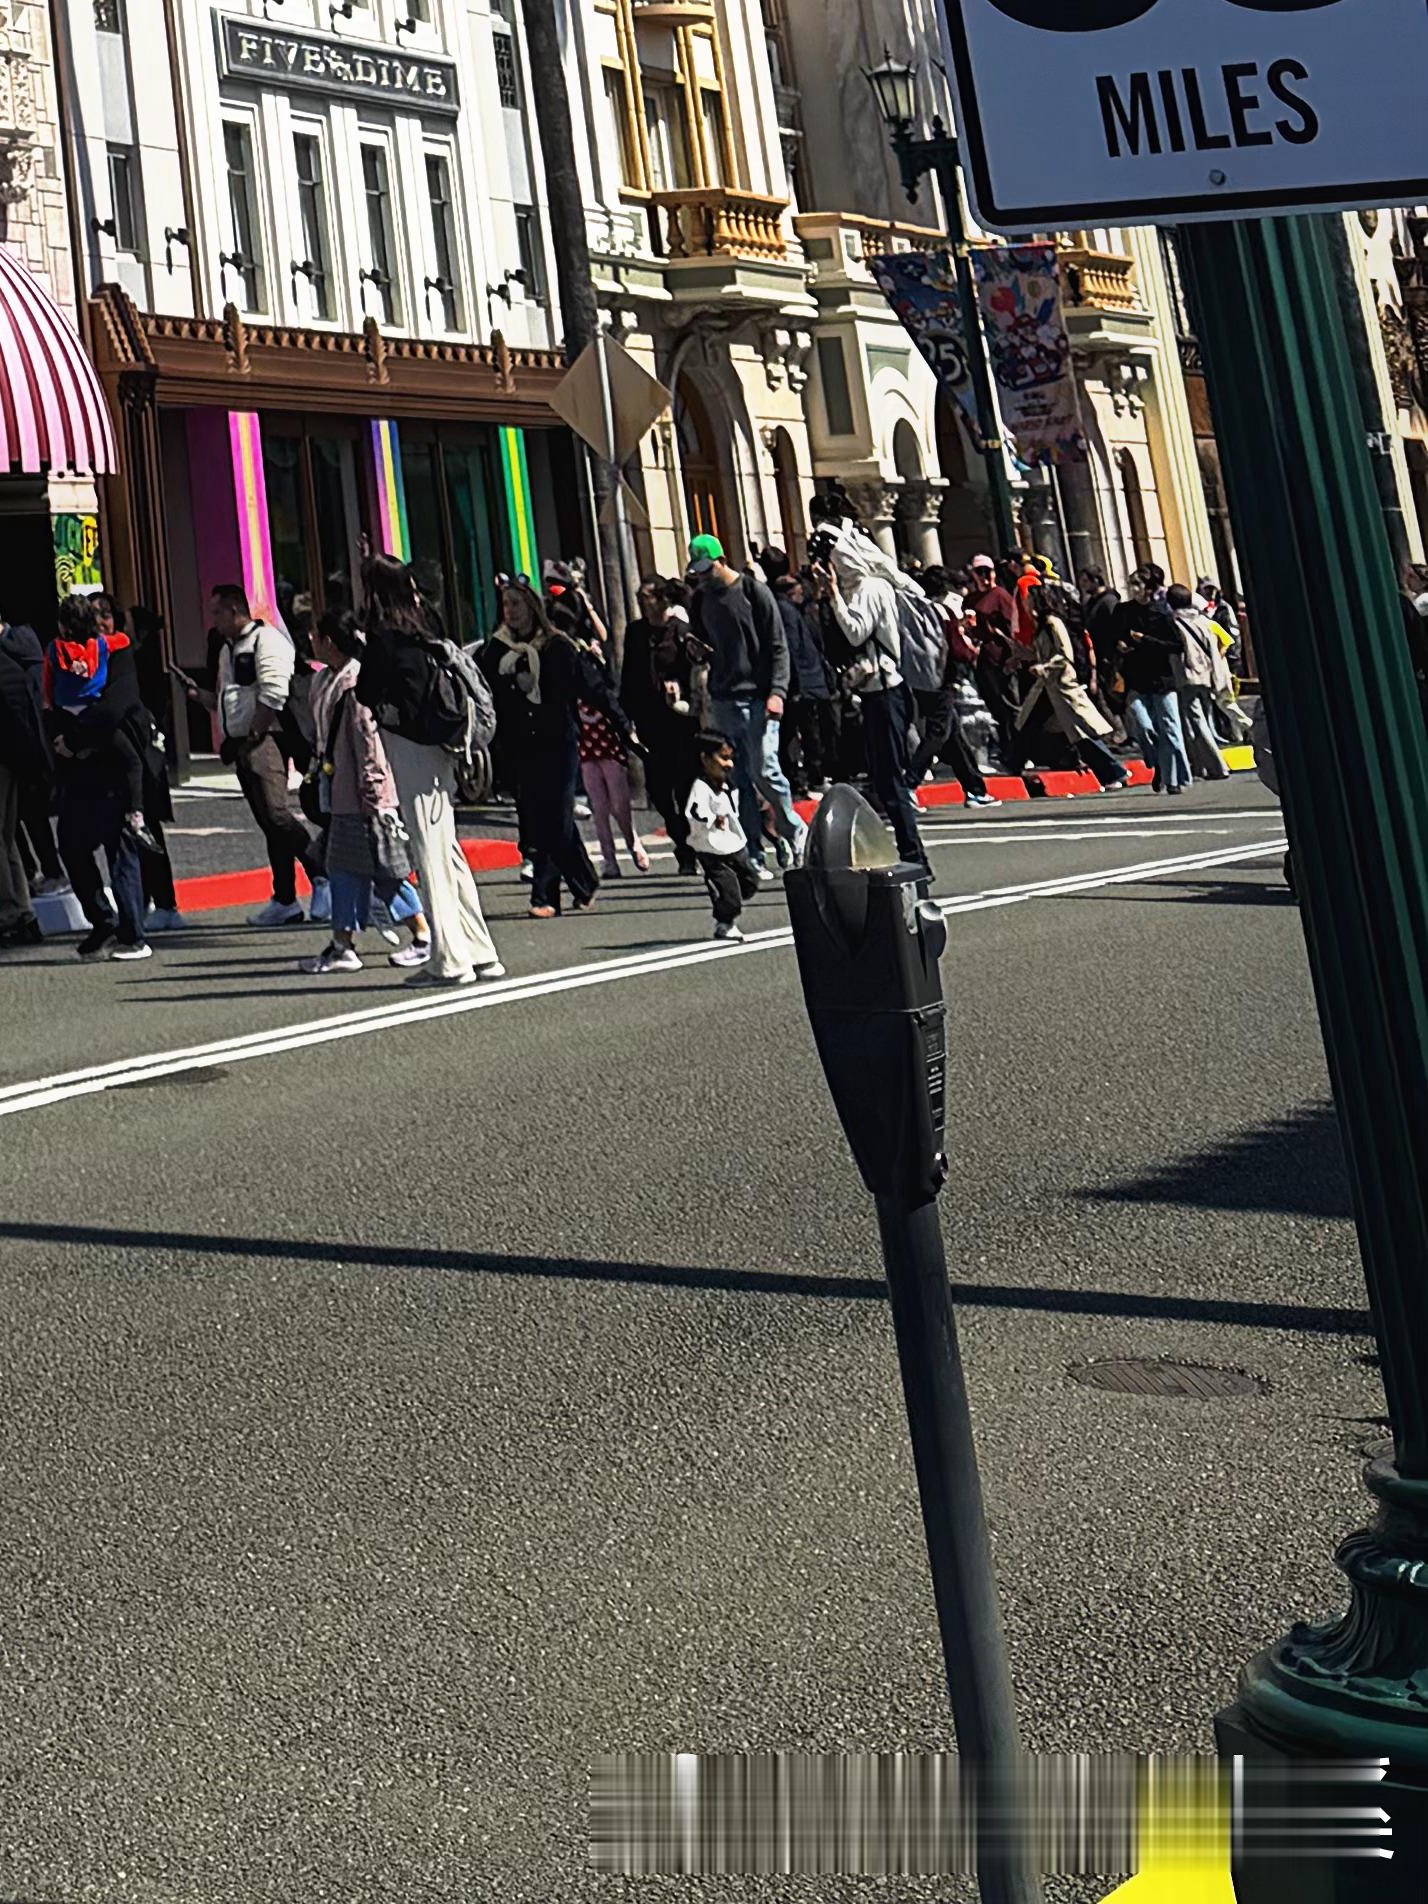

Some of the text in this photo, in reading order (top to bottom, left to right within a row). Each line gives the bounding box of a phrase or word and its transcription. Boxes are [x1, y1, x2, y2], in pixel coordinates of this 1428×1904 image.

[238, 31, 325, 74] FIVE
[352, 53, 447, 96] DIME
[1097, 56, 1320, 158] MILES
